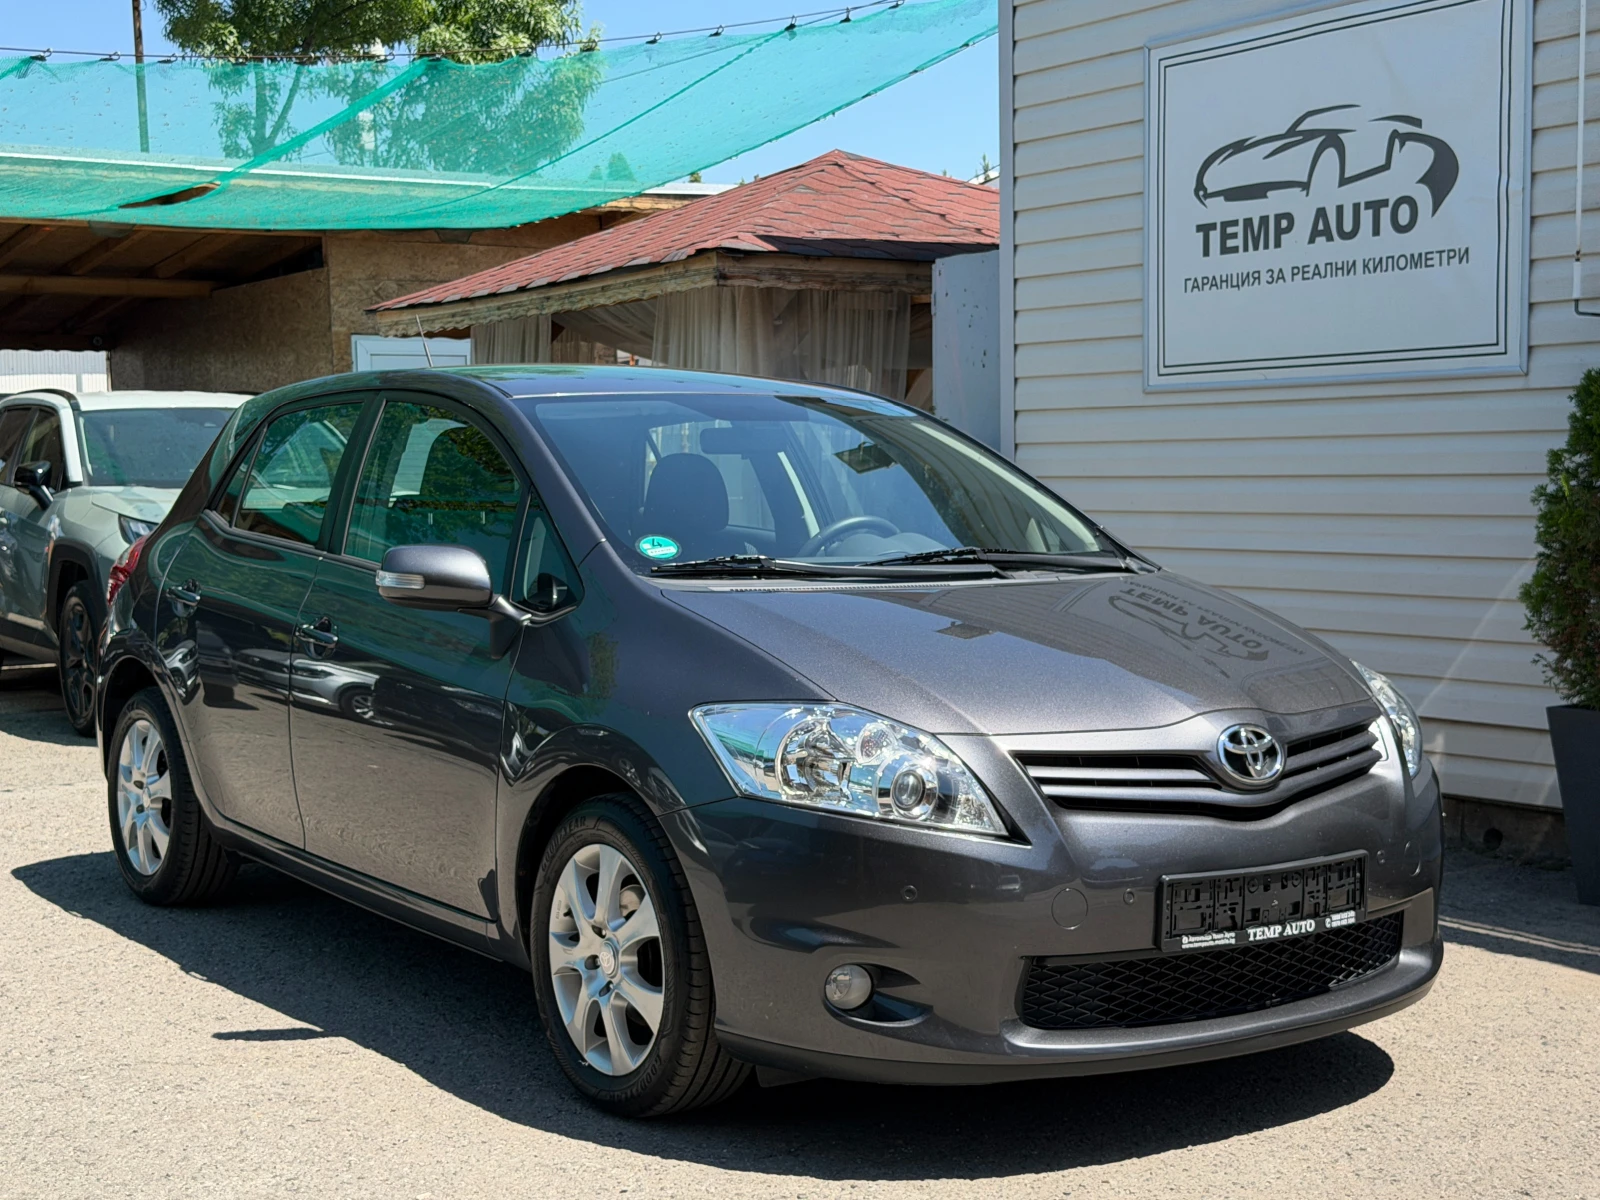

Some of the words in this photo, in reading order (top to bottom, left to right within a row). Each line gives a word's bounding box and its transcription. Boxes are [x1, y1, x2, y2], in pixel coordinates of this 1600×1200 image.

[1196, 212, 1295, 257] TEMP
[1307, 195, 1418, 245] AUTO
[1184, 270, 1261, 293] ГАРАНЦИЯ
[1266, 268, 1286, 284] ЗА
[1291, 260, 1356, 282] РЕАЛНИ
[1362, 247, 1470, 275] КИЛОМЕТРИ
[1246, 925, 1282, 942] TEMP
[1283, 919, 1316, 936] AUTO
